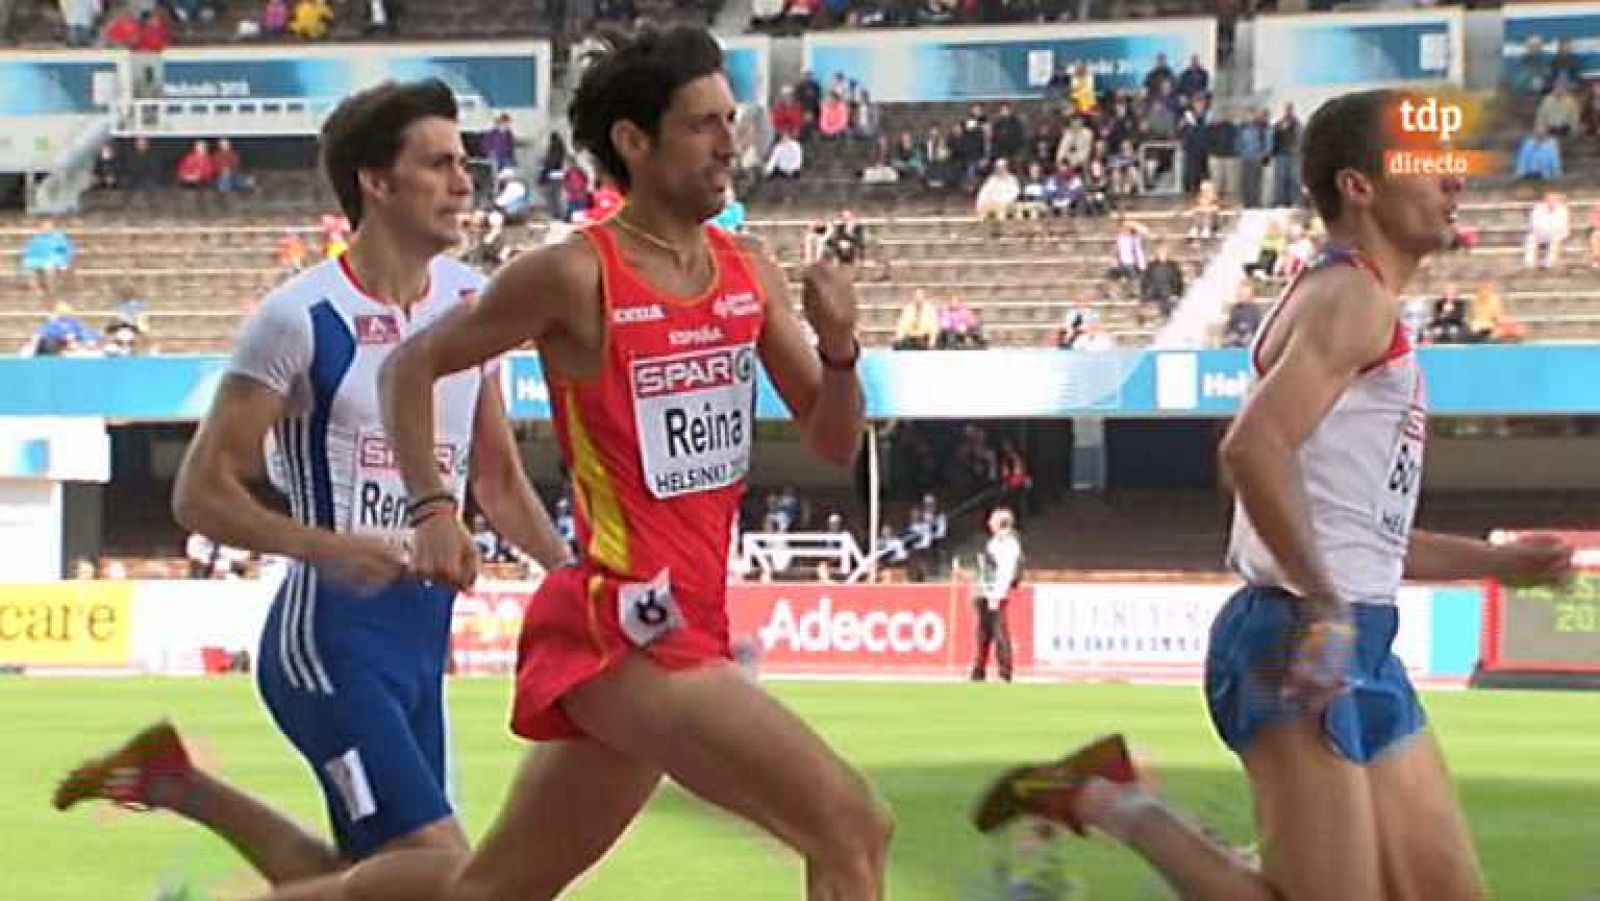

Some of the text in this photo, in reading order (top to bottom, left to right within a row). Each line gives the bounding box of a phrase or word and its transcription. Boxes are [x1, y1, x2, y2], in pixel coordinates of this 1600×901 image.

[635, 355, 731, 393] SPAR
[665, 402, 742, 458] Reina
[0, 605, 116, 641] care
[757, 596, 945, 652] Adecco
